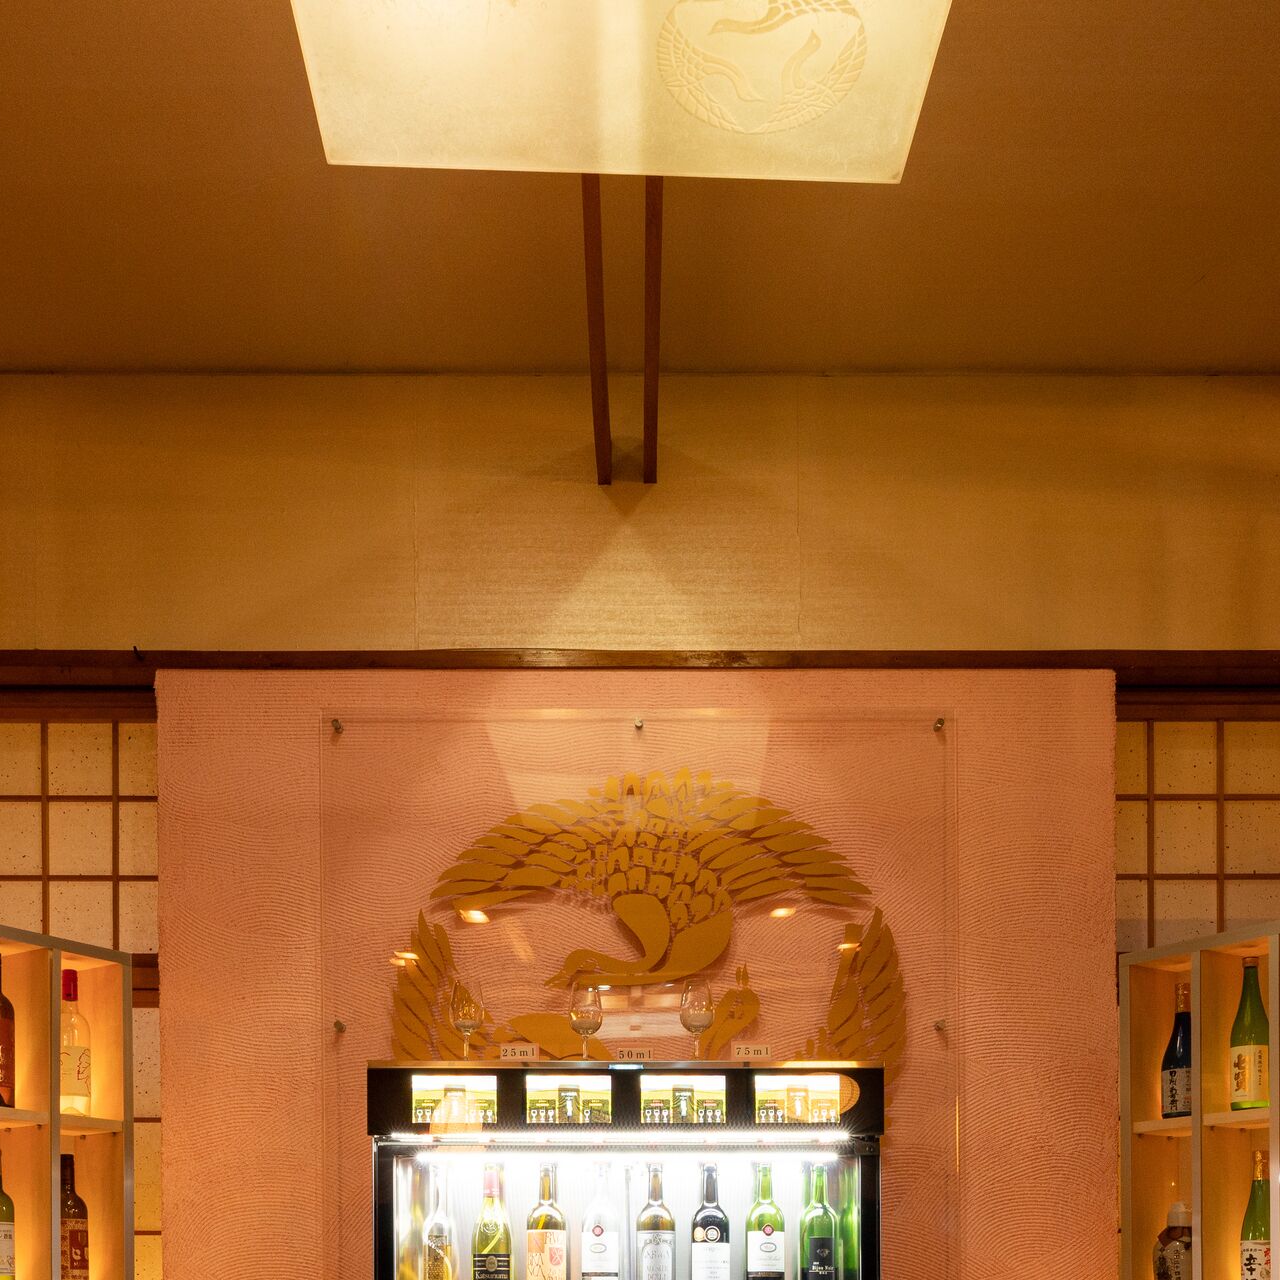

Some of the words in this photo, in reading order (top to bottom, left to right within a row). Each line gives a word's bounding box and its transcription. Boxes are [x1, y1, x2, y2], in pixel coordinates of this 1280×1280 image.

[502, 1047, 535, 1057] 25ml
[618, 1050, 651, 1059] 50ml
[736, 1047, 769, 1057] 75ml
